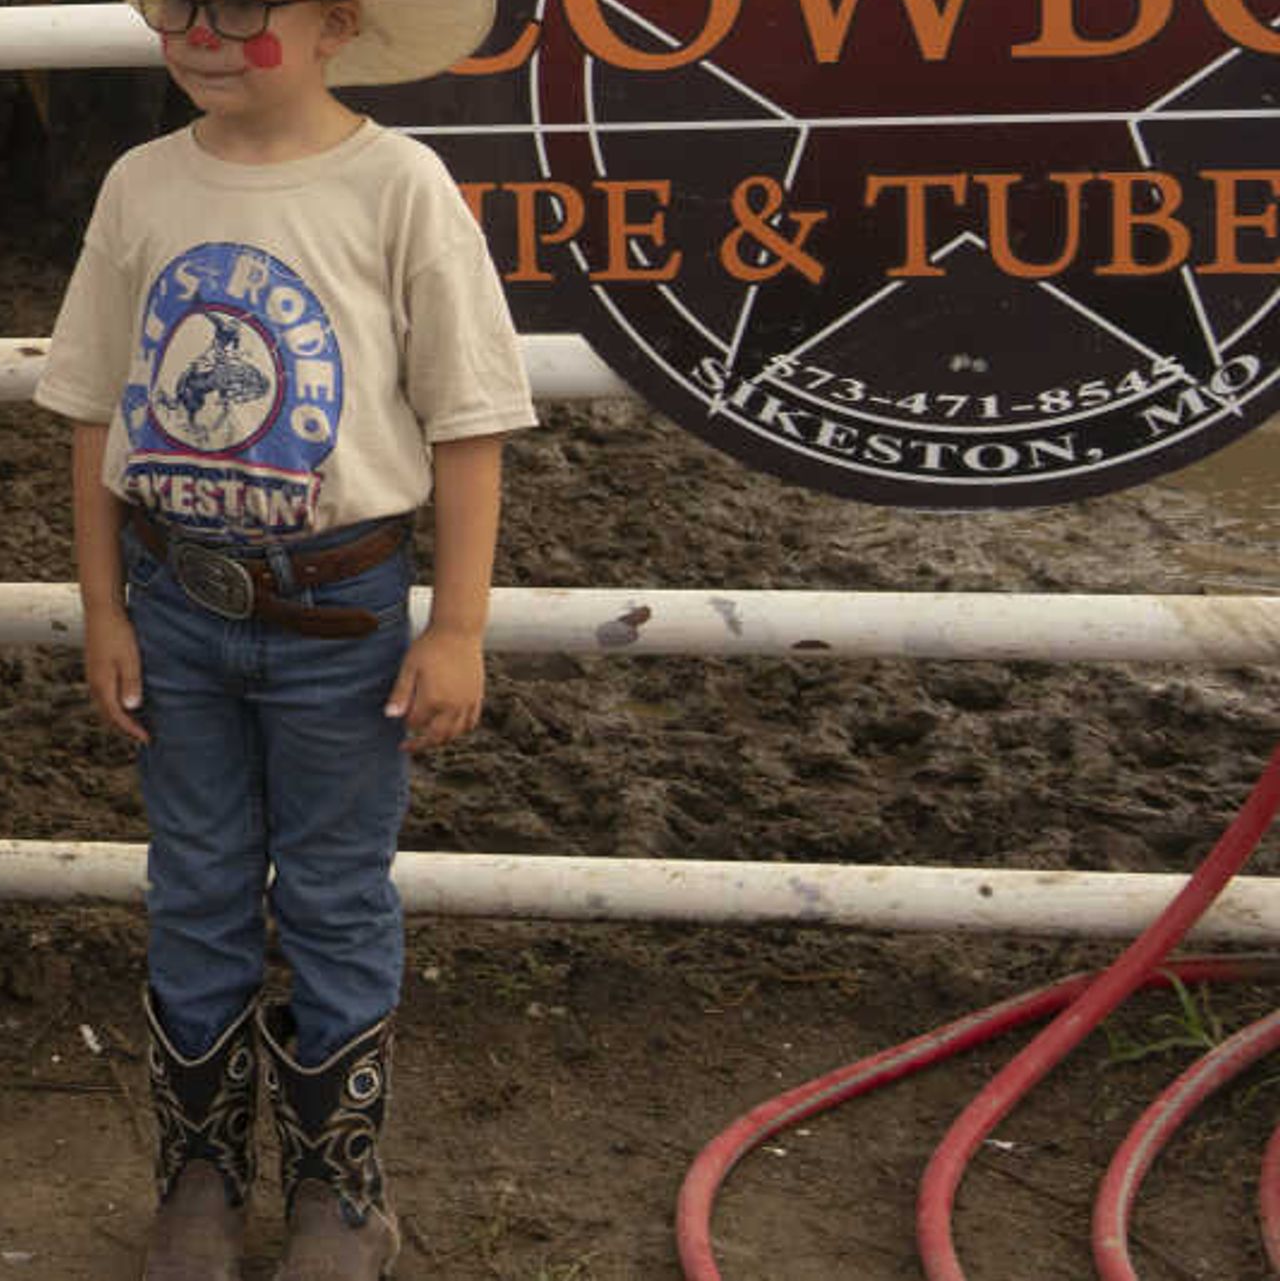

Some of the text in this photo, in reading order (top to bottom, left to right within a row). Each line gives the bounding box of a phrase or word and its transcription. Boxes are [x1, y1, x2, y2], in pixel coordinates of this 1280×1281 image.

[719, 175, 828, 284] &
[225, 250, 336, 443] RODEO
[763, 353, 1185, 419] 573-471-8545
[691, 353, 1261, 471] SIKESTON, MO
